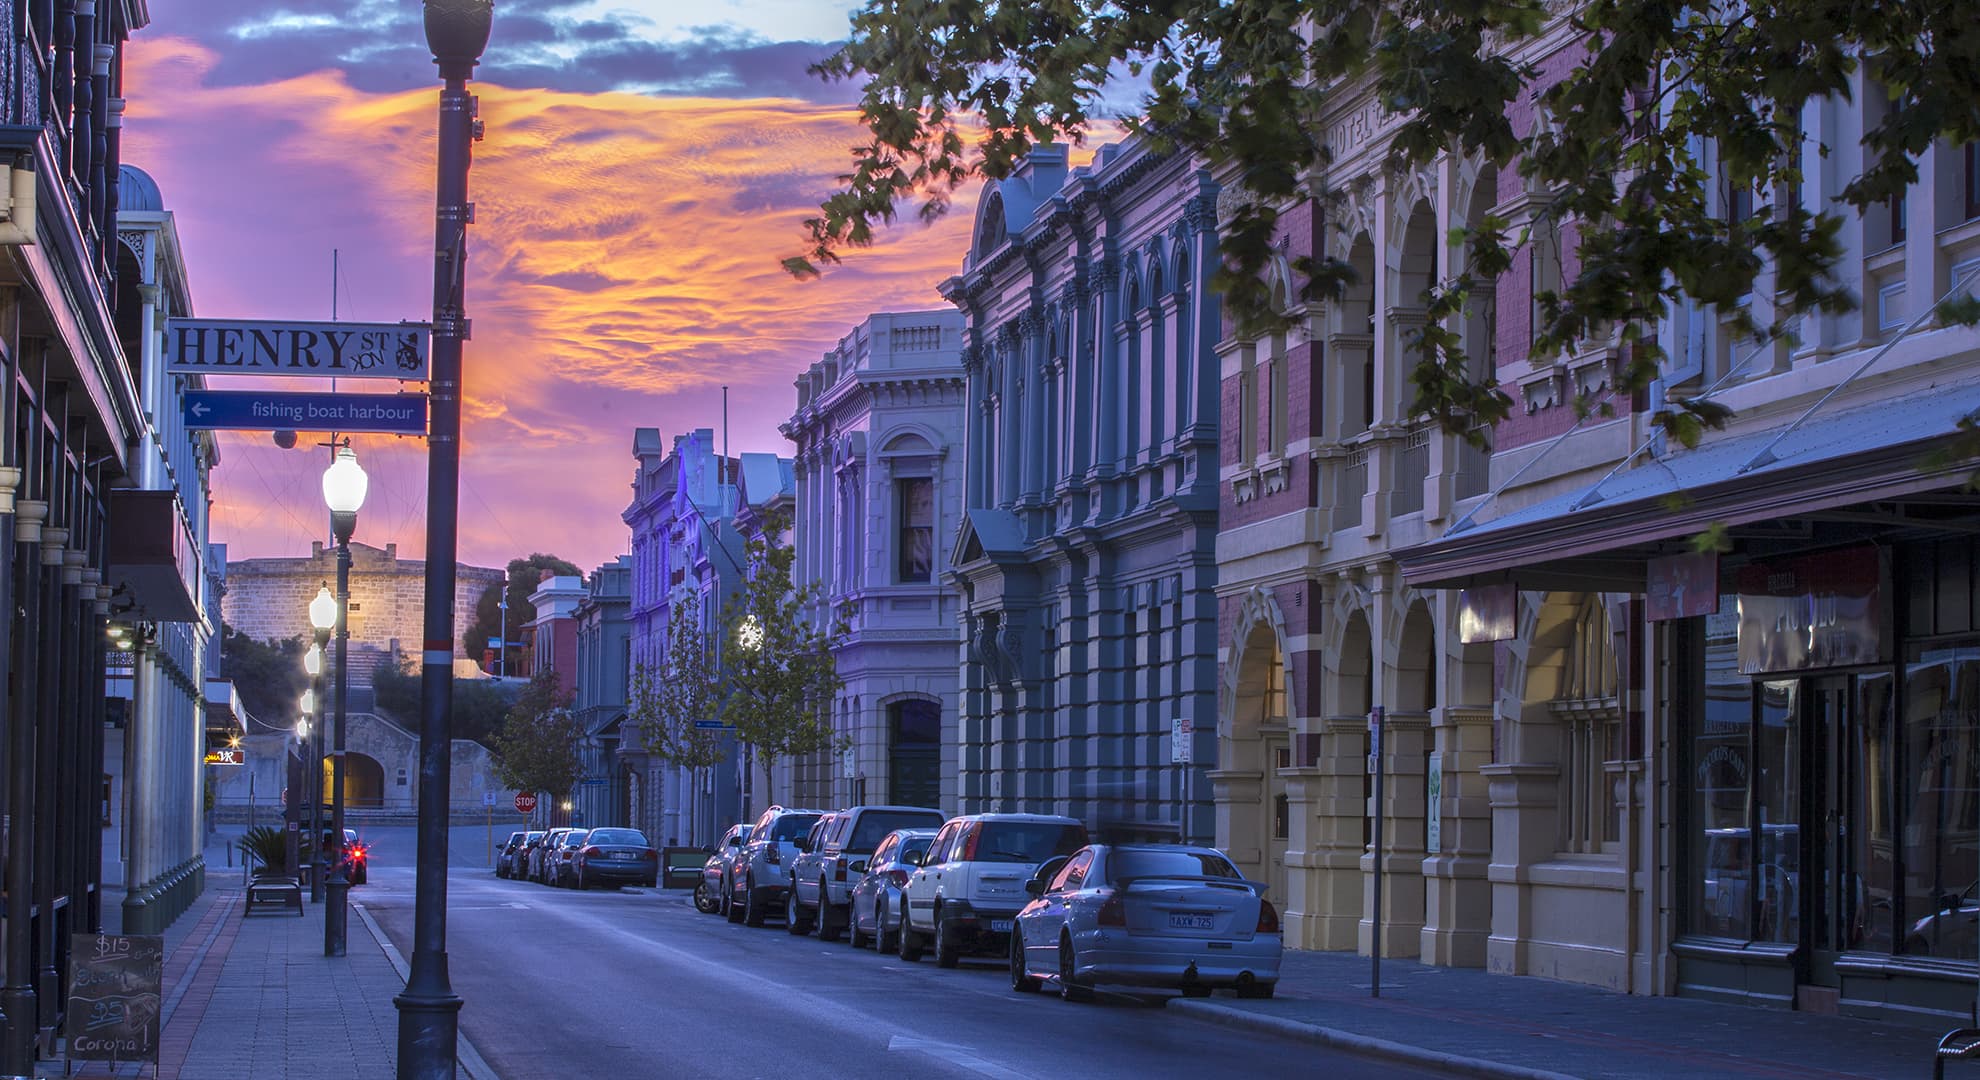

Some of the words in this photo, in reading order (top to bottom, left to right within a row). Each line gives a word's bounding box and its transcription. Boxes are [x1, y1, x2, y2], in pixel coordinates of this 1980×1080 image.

[173, 327, 355, 369] HENRY
[361, 331, 390, 350] ST
[252, 401, 303, 422] fishing
[308, 402, 345, 419] boat
[349, 402, 415, 420] harbour
[515, 797, 535, 806] STOP
[95, 935, 130, 957] $15
